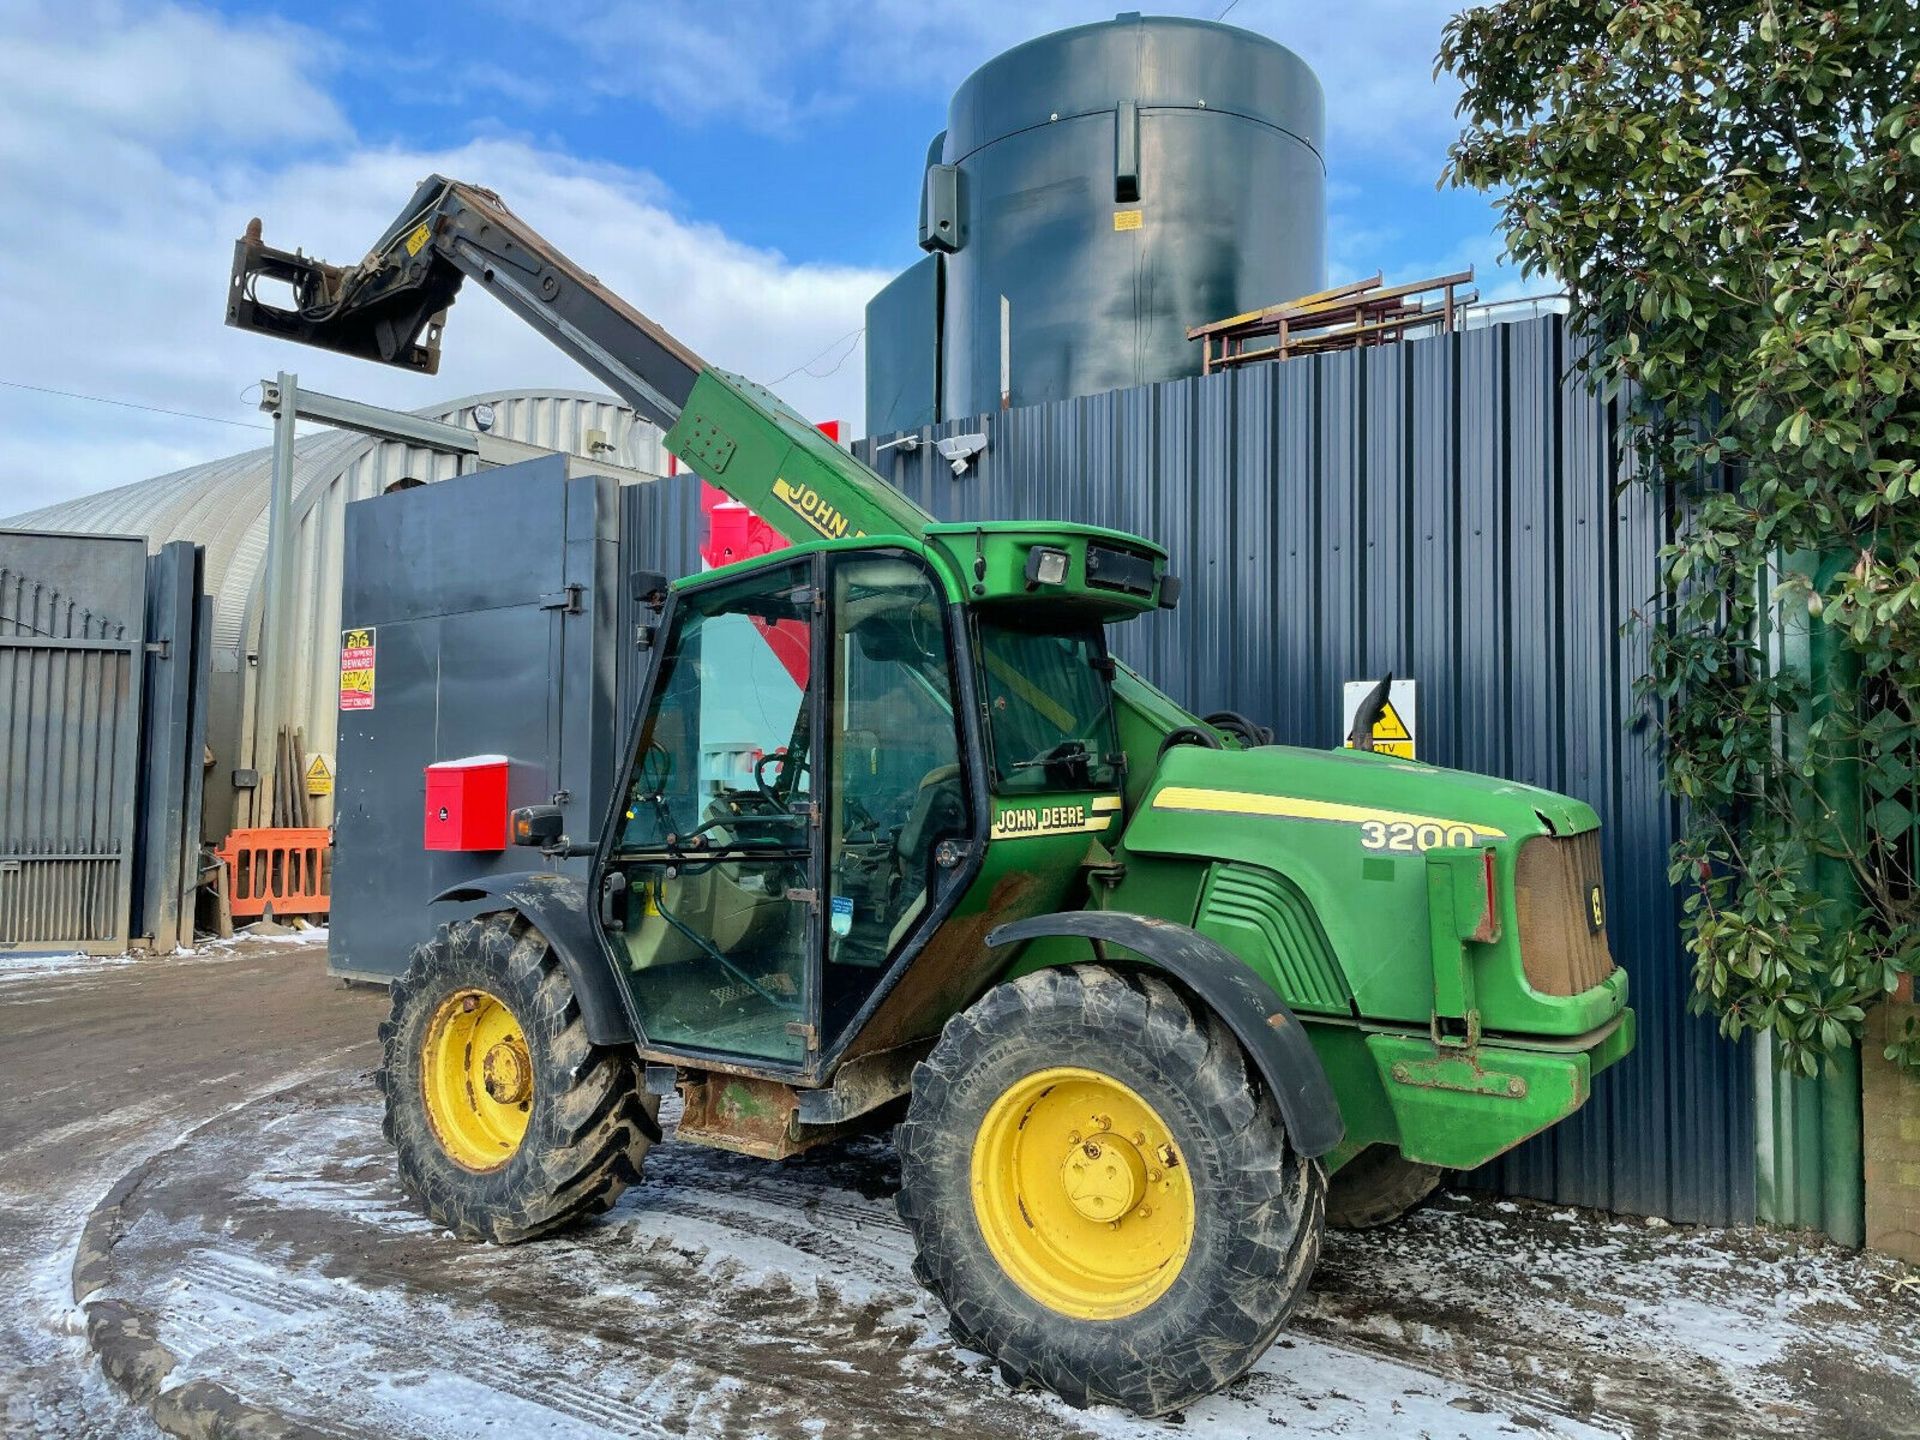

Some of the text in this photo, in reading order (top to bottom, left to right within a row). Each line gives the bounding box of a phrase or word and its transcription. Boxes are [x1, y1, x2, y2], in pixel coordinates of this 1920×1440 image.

[787, 482, 849, 538] JOHN
[342, 657, 373, 669] BEWARE!
[343, 671, 361, 681] CCTV
[1371, 743, 1396, 753] CTV
[997, 806, 1085, 832] JOHN DEERE
[1361, 820, 1473, 851] 3200
